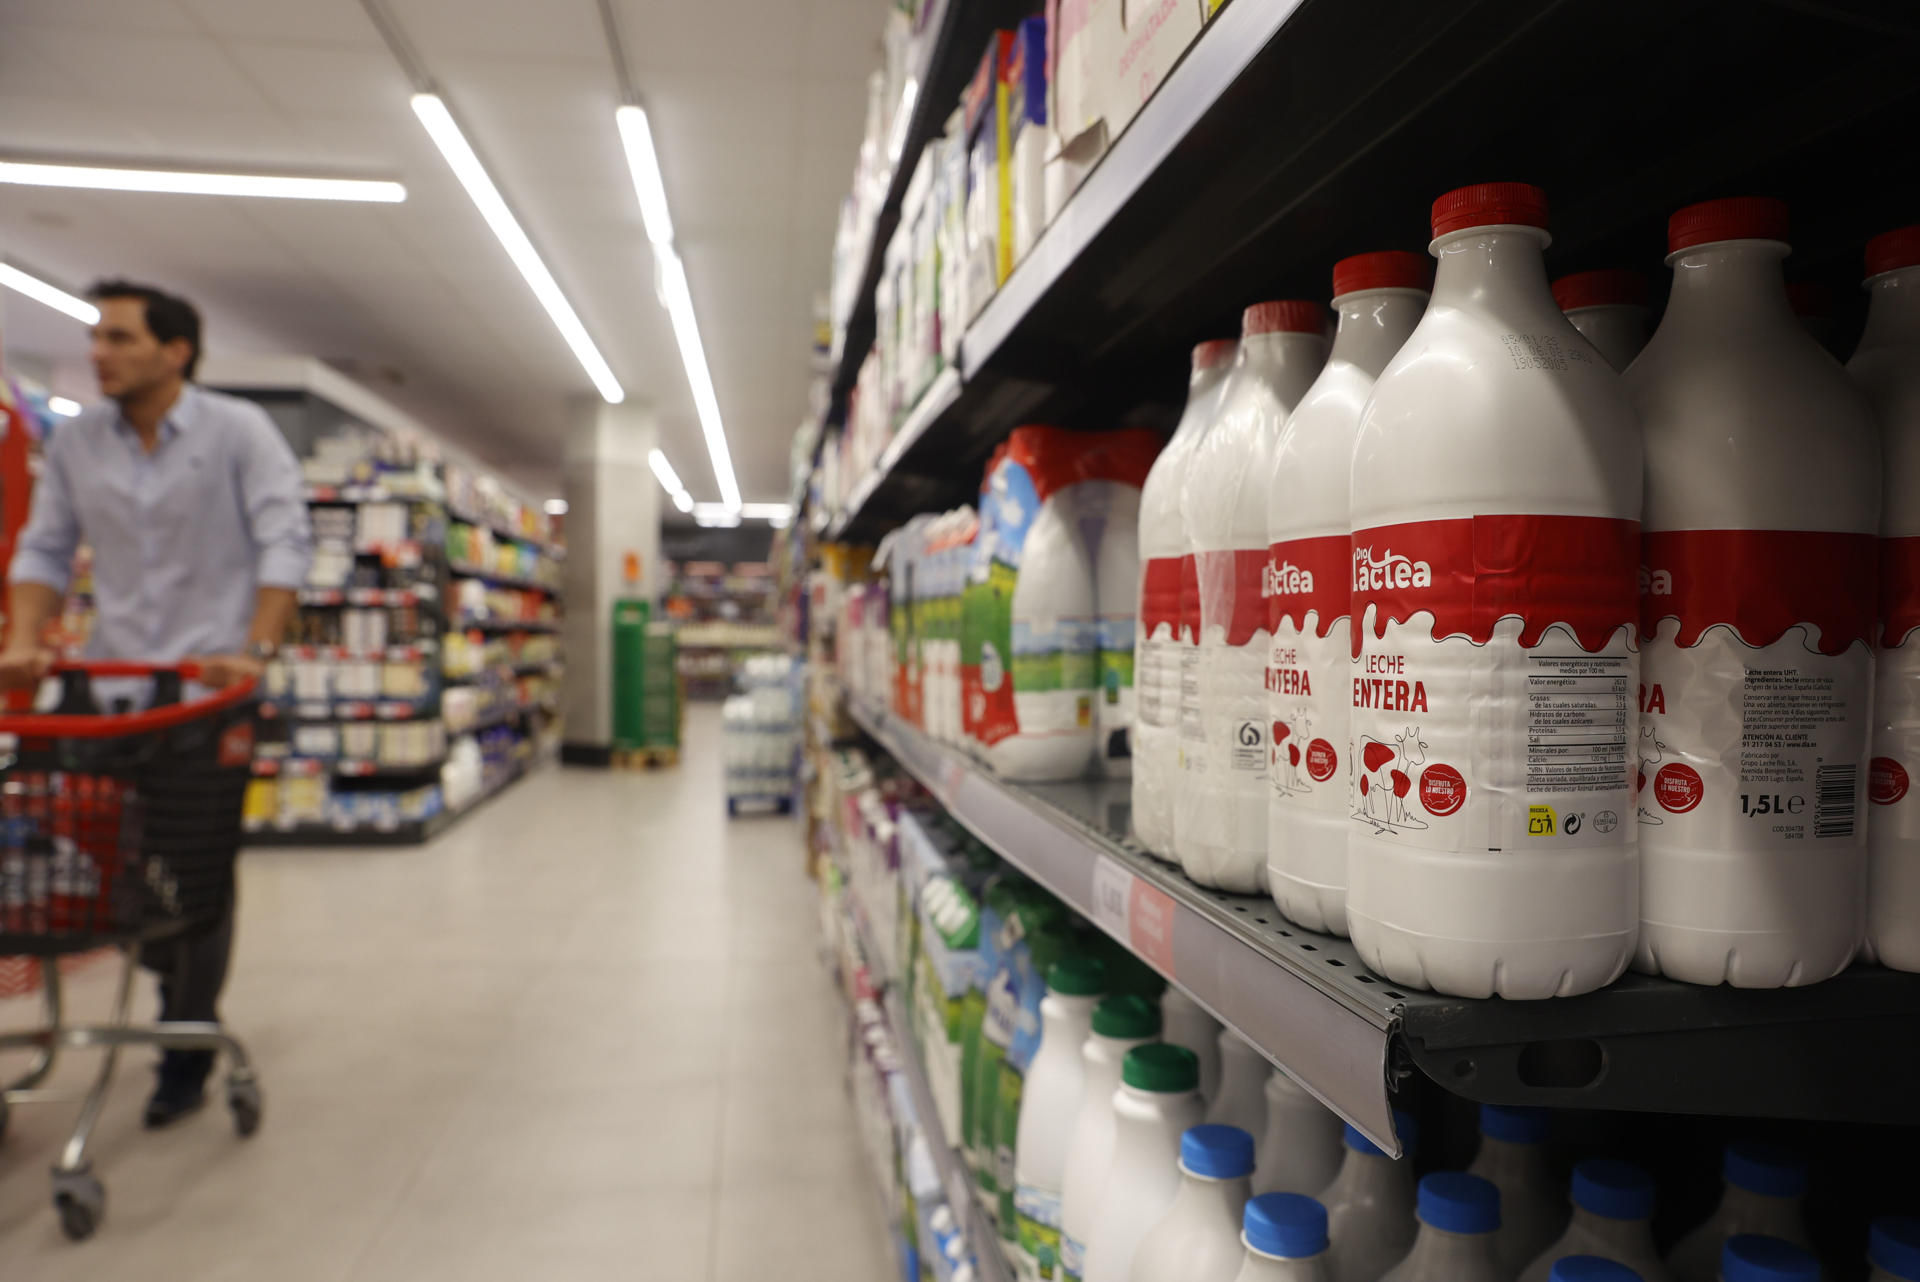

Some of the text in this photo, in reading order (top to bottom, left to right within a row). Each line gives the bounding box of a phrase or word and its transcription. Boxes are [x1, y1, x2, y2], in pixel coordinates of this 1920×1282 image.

[1366, 655, 1404, 674] LECHE
[1353, 678, 1428, 712] ENTERA
[1432, 787, 1454, 795] NUESTRO
